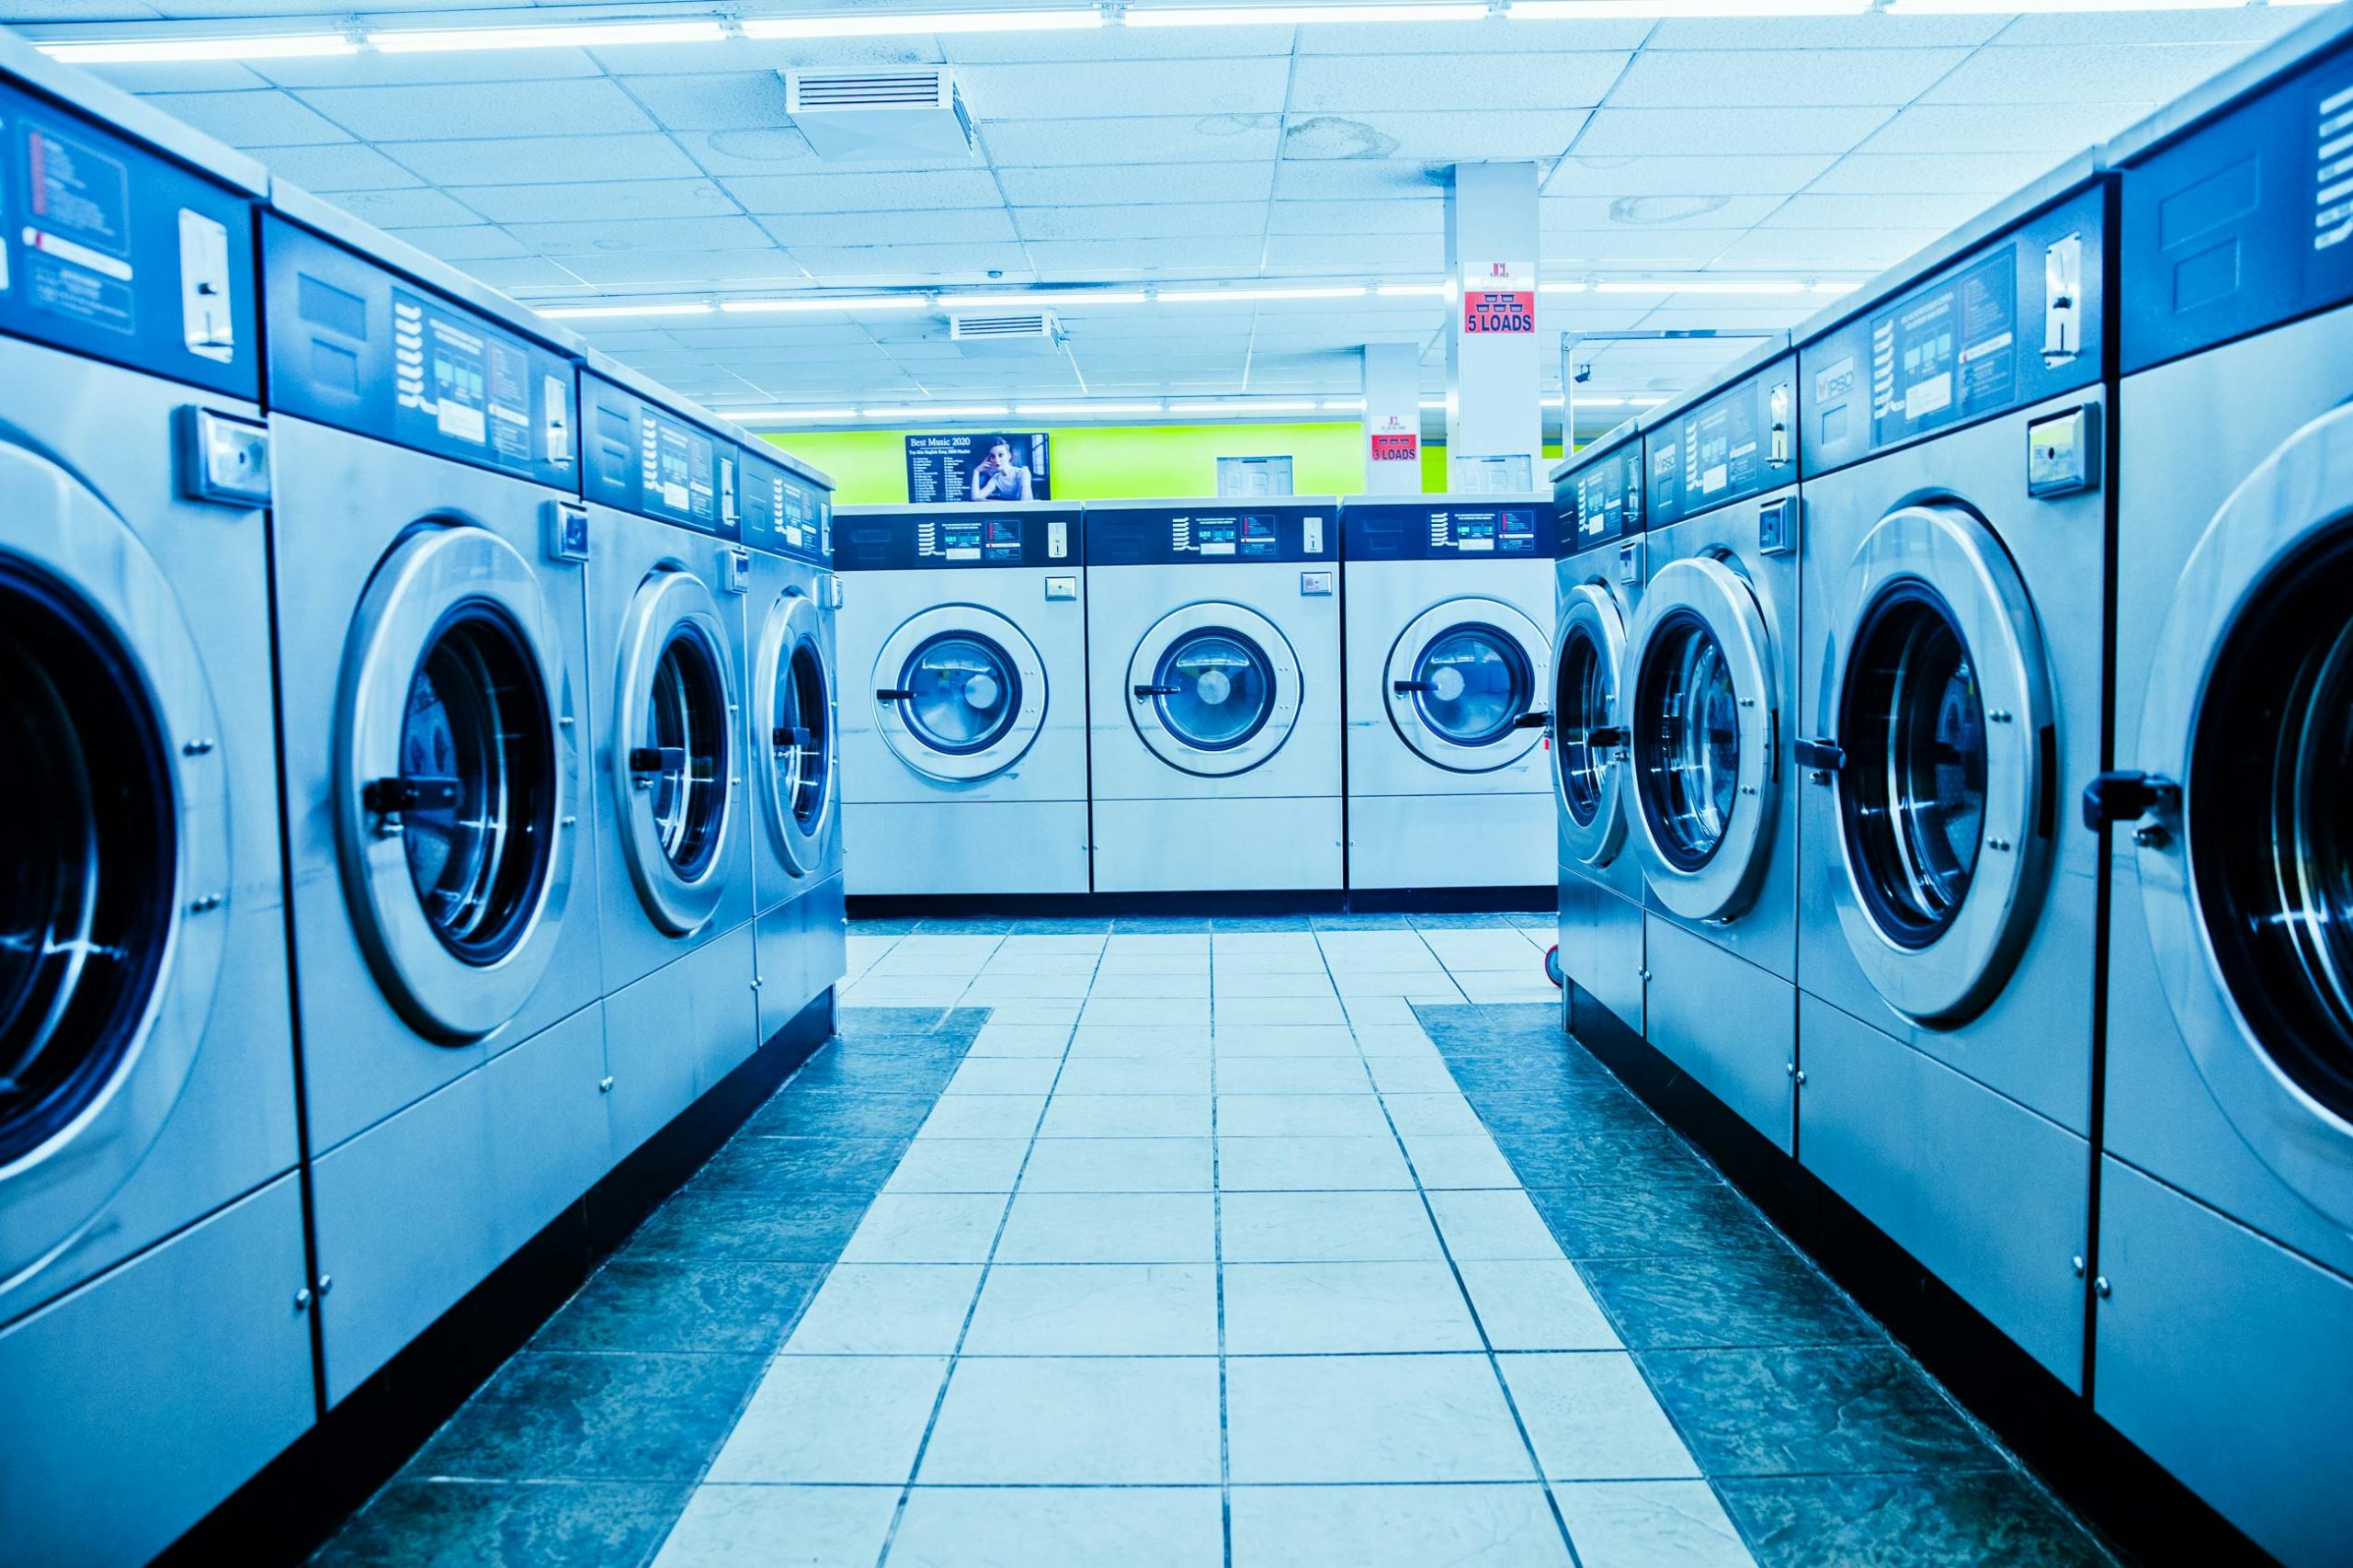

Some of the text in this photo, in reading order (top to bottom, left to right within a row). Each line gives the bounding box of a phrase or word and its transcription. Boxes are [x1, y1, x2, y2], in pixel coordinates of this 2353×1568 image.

[1468, 314, 1532, 332] 5 LOADS
[910, 437, 971, 447] Best Music 2020
[1374, 449, 1415, 460] 3 LOADS
